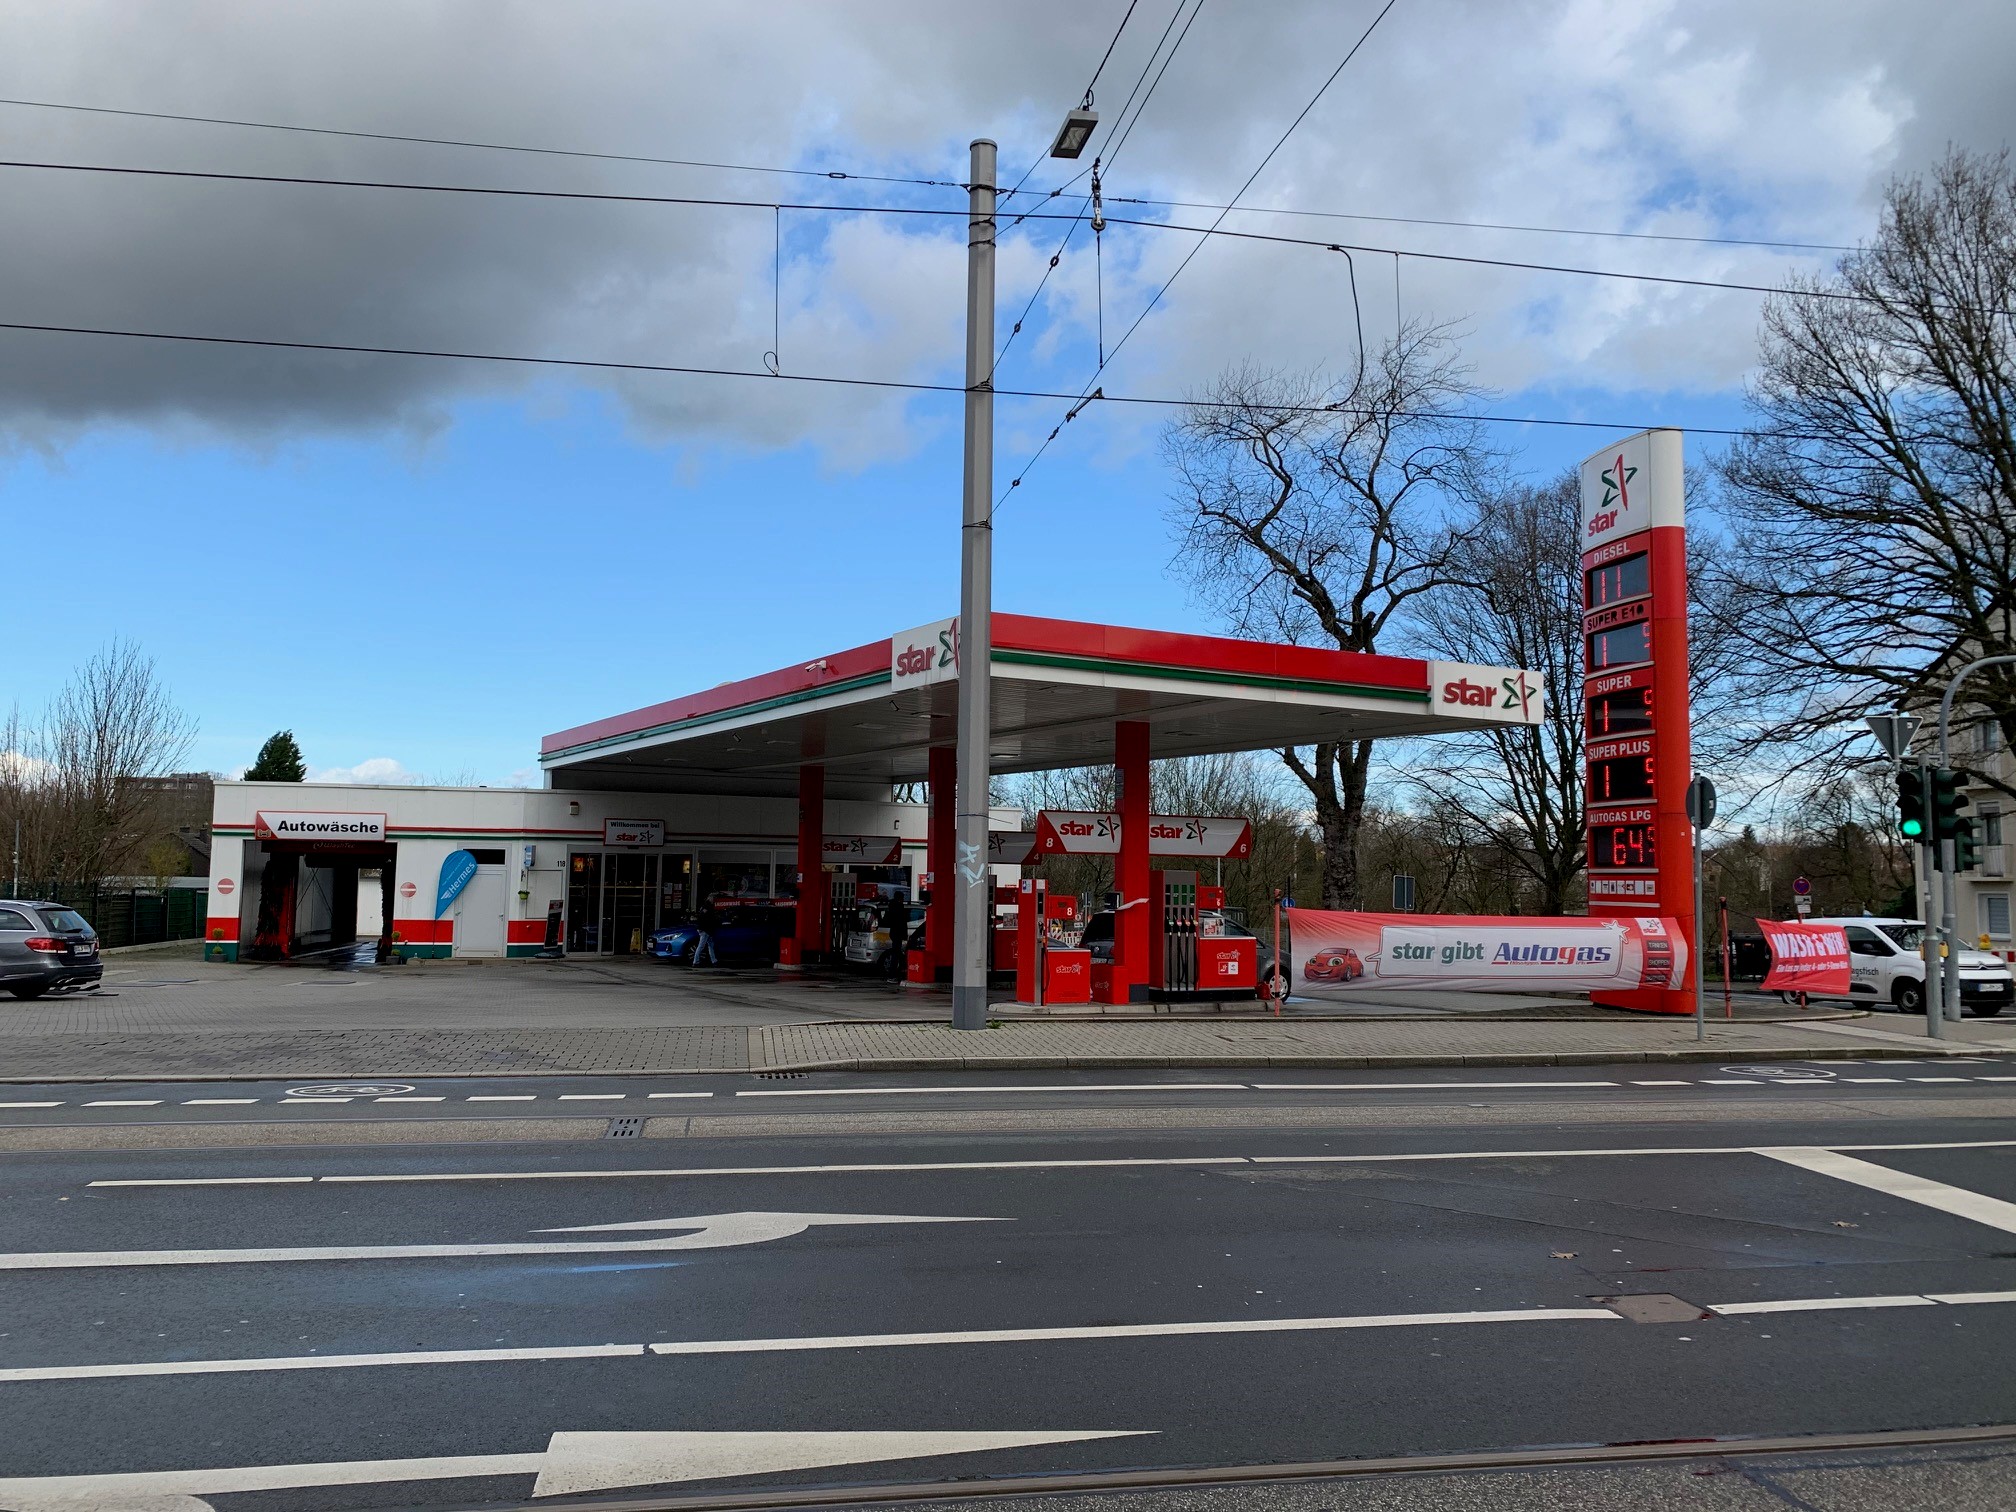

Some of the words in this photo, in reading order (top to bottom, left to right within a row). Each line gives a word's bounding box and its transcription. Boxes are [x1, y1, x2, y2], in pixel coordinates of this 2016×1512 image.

[1588, 509, 1618, 537] star
[1593, 542, 1631, 564] DIESEL
[1587, 611, 1618, 631] SUPER
[896, 644, 936, 677] star
[1597, 675, 1632, 693] SUPER
[1443, 678, 1497, 707] star
[1588, 744, 1617, 760] SUPER
[1619, 740, 1651, 756] PLUS
[1589, 811, 1628, 824] AUTOGAS
[1630, 809, 1652, 821] LPG
[277, 820, 379, 833] Autowäsche
[1059, 820, 1094, 836] star
[1150, 823, 1183, 839] star
[616, 832, 638, 842] star
[1046, 838, 1054, 848] 8
[822, 840, 849, 852] star
[1240, 843, 1247, 853] 6
[557, 860, 566, 868] 118
[1033, 852, 1040, 861] 4
[448, 862, 475, 894] Hermes
[1067, 907, 1073, 916] 8
[1392, 942, 1436, 960] star
[1441, 940, 1485, 964] gibt
[1494, 942, 1612, 964] Autogas
[1771, 933, 1815, 958] WASH
[1056, 964, 1071, 974] star
